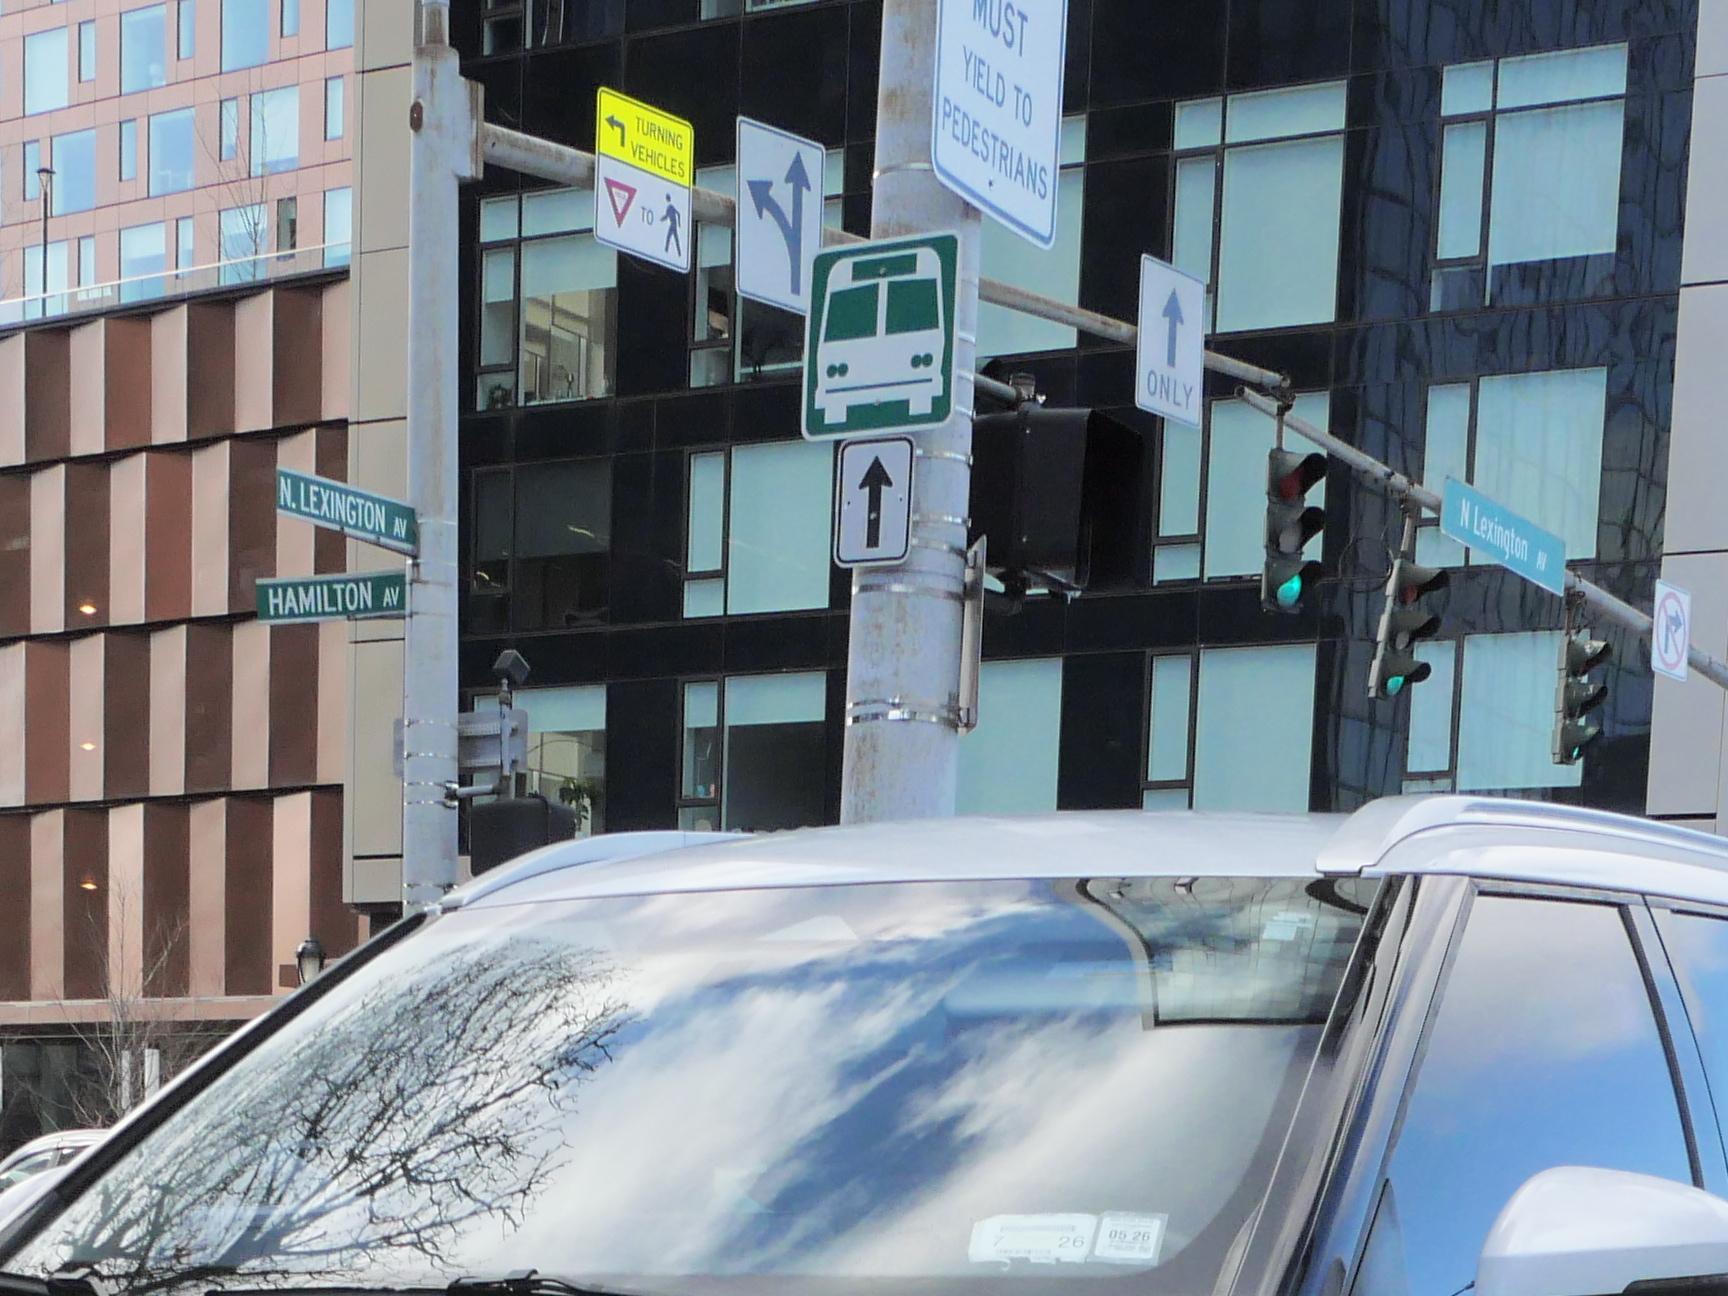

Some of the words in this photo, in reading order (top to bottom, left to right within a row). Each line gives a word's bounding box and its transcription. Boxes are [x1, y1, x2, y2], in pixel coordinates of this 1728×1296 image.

[963, 45, 1006, 108] YIELD
[1014, 85, 1032, 128] TO
[635, 115, 683, 150] TURNING
[942, 97, 1047, 200] PEDESTRIANS
[630, 141, 685, 178] VEHICLES
[641, 206, 654, 225] TO
[1147, 369, 1193, 410] ONLY
[279, 476, 296, 509] N.
[300, 482, 385, 534] LEXINGTON
[393, 517, 407, 538] AV
[1460, 498, 1470, 529] N
[1473, 505, 1528, 561] Lexington
[1536, 549, 1547, 571] AV
[268, 581, 372, 616] HAMILTON
[383, 586, 399, 608] AV
[1058, 1236, 1085, 1249] 26
